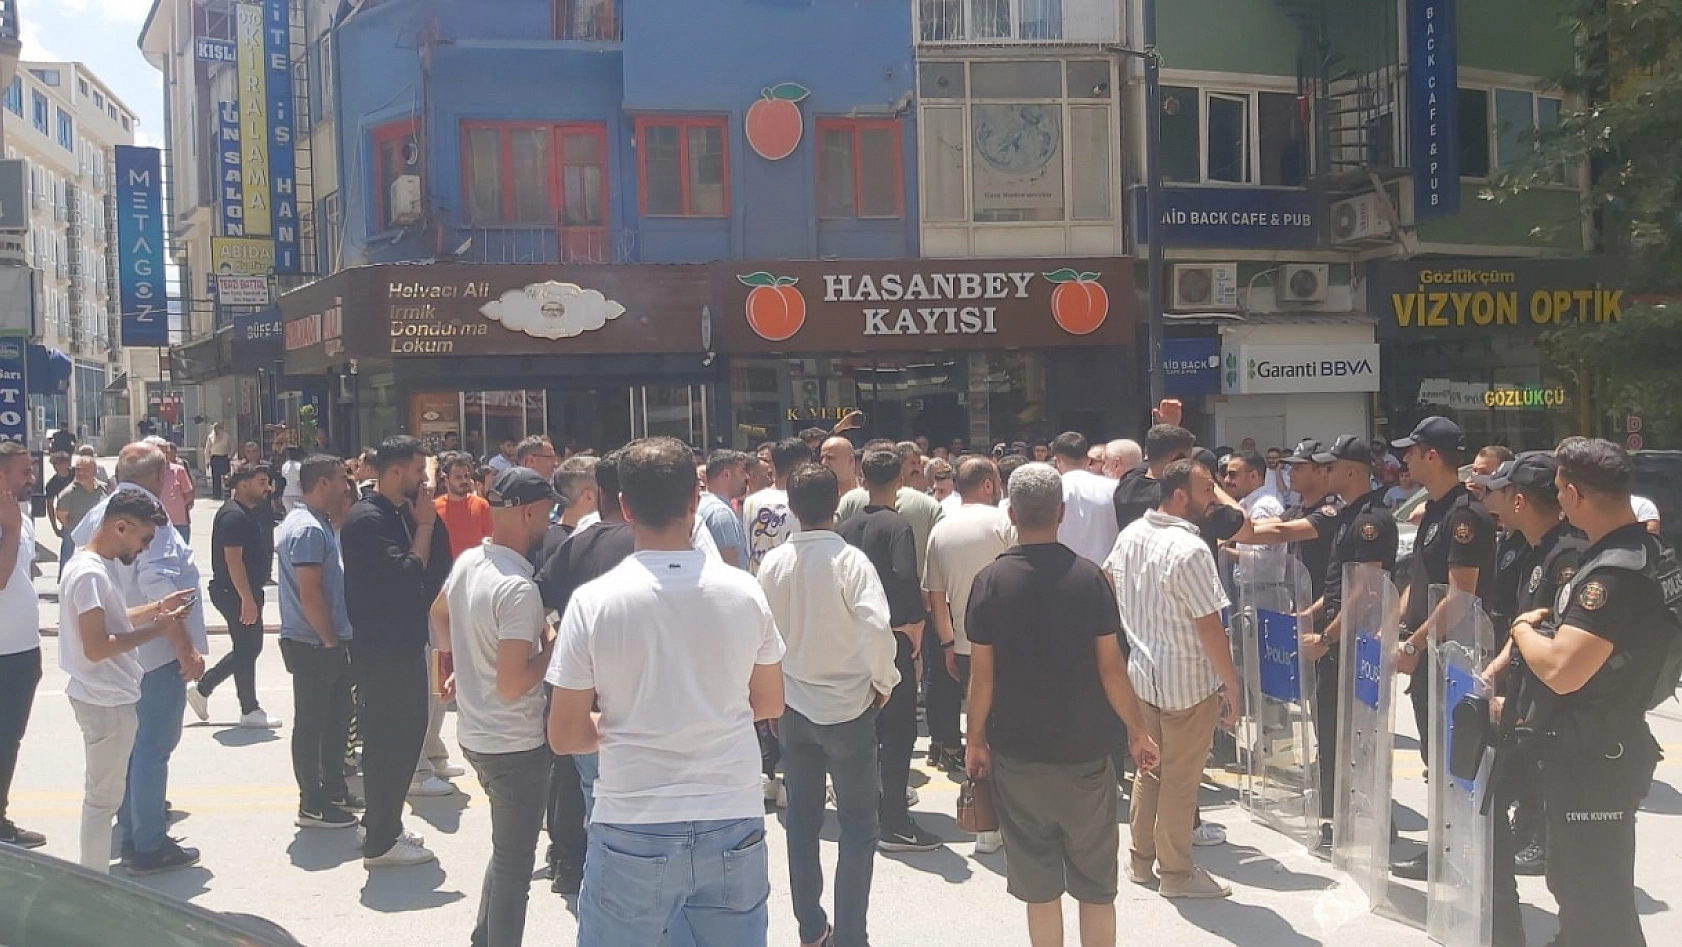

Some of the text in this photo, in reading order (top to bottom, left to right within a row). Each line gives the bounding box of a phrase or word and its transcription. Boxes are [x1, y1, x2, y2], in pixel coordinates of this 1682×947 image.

[1426, 7, 1439, 205] BACK CAFE & PUB
[277, 177, 294, 267] HANI
[1160, 208, 1312, 226] AİD BACK CAFE & PUB
[389, 282, 490, 298] Helvacı Ali
[823, 272, 1035, 301] HASANBEY
[1392, 282, 1624, 327] VİZYON OPTİK
[390, 321, 487, 337] Dondurma
[862, 307, 998, 335] KAYISI
[390, 337, 454, 353] Lokum
[1181, 360, 1208, 370] BACK
[1257, 358, 1373, 378] Garanti BBVA
[1485, 386, 1564, 409] GÖZLÜKÇÜ
